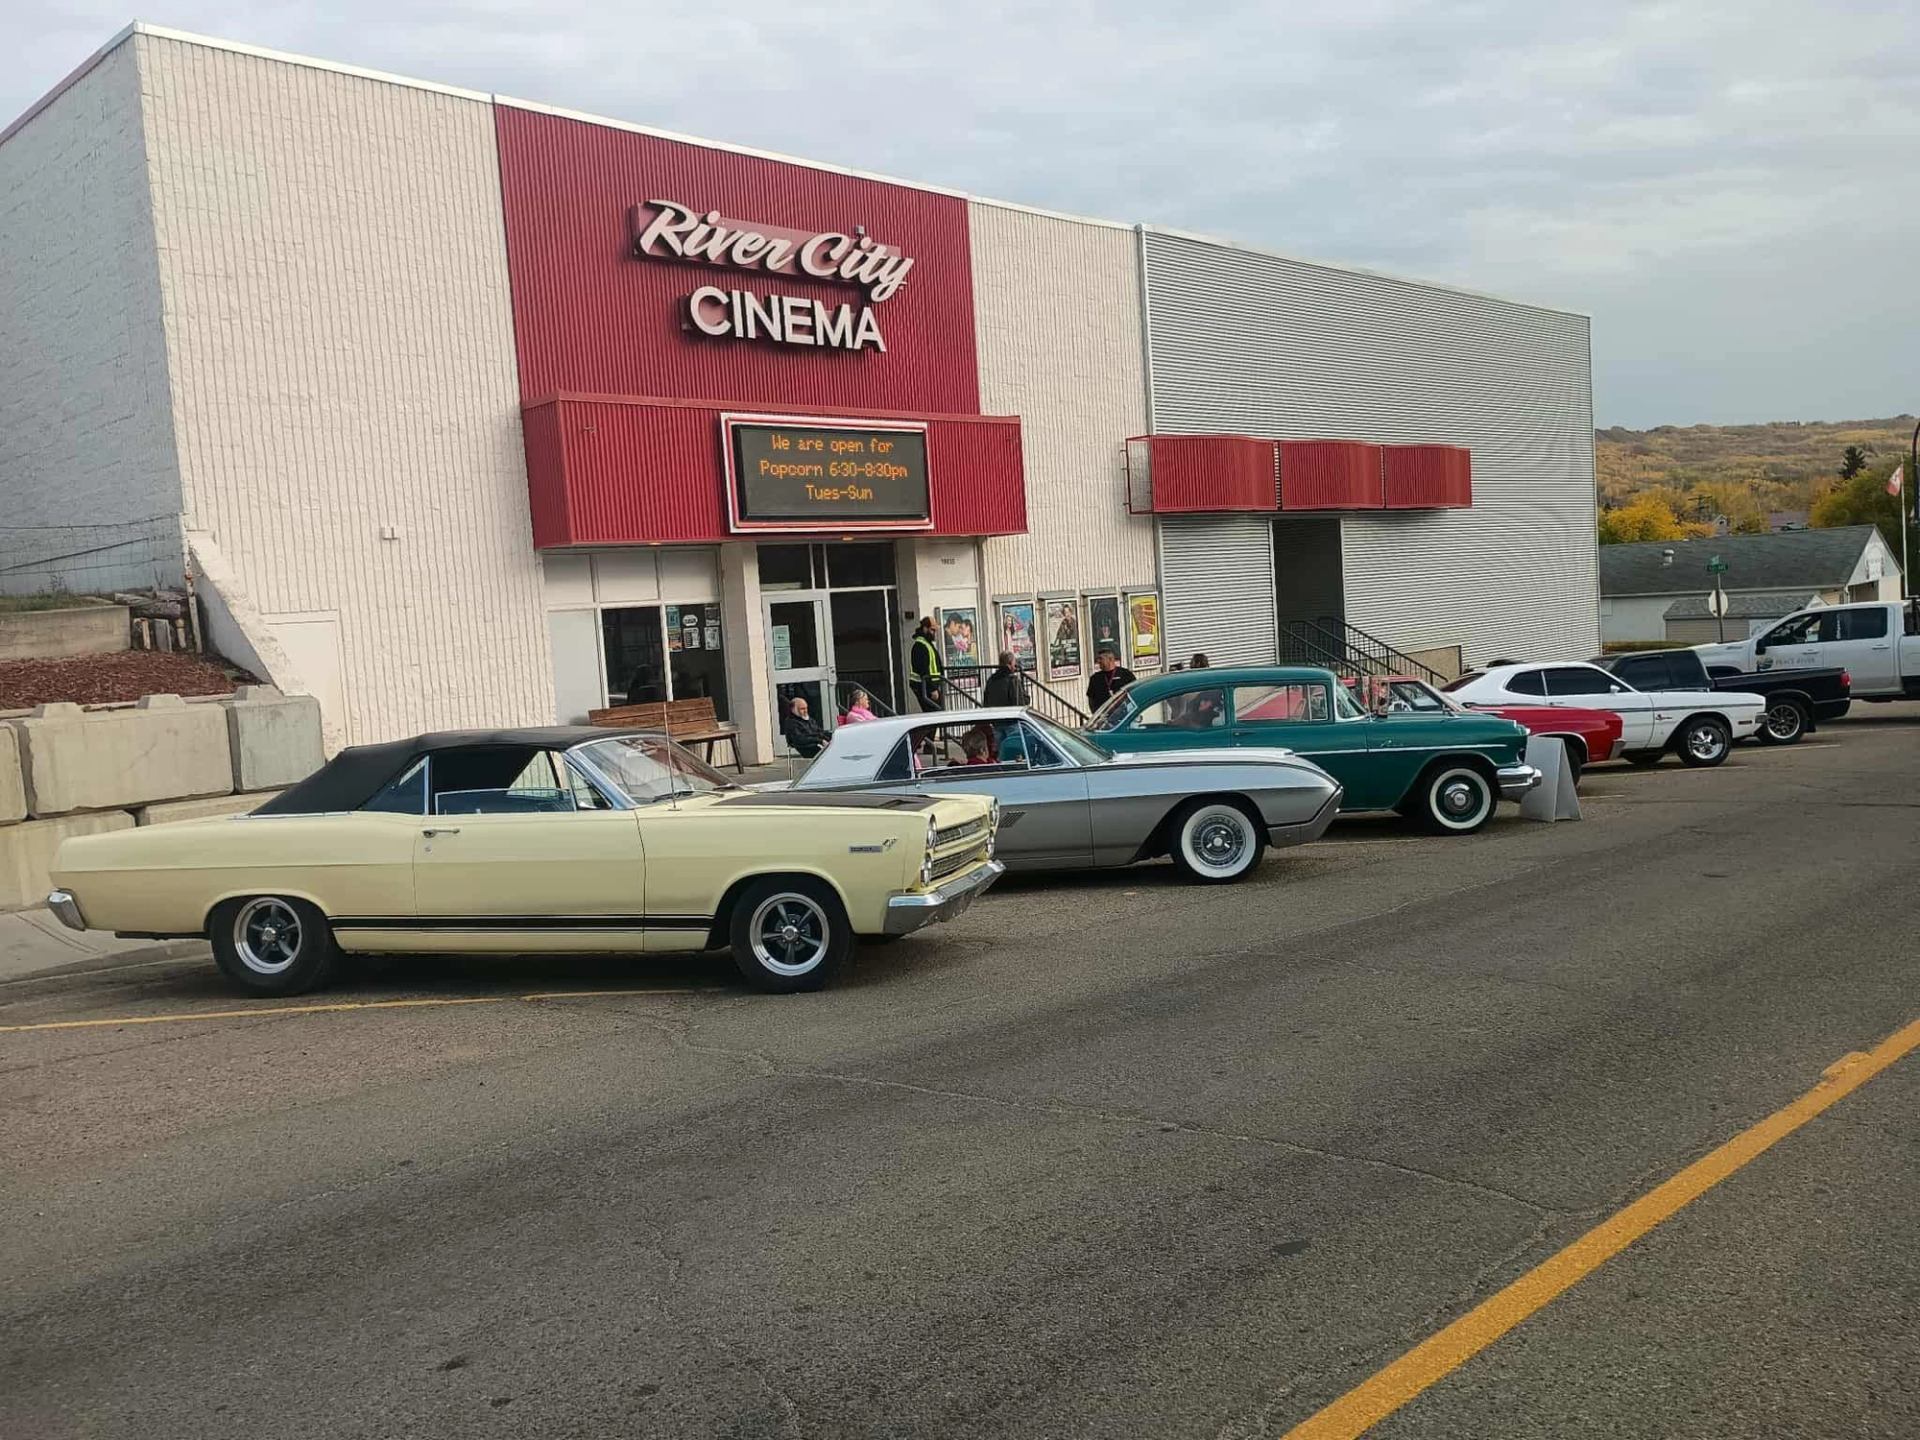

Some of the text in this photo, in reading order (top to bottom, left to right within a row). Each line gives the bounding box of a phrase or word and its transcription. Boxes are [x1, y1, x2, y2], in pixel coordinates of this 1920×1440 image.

[640, 199, 915, 303] River City
[690, 286, 887, 352] CINEMA
[771, 434, 895, 455] We are open for
[759, 459, 824, 479] Popcorn
[805, 484, 873, 501] Tues-Sun
